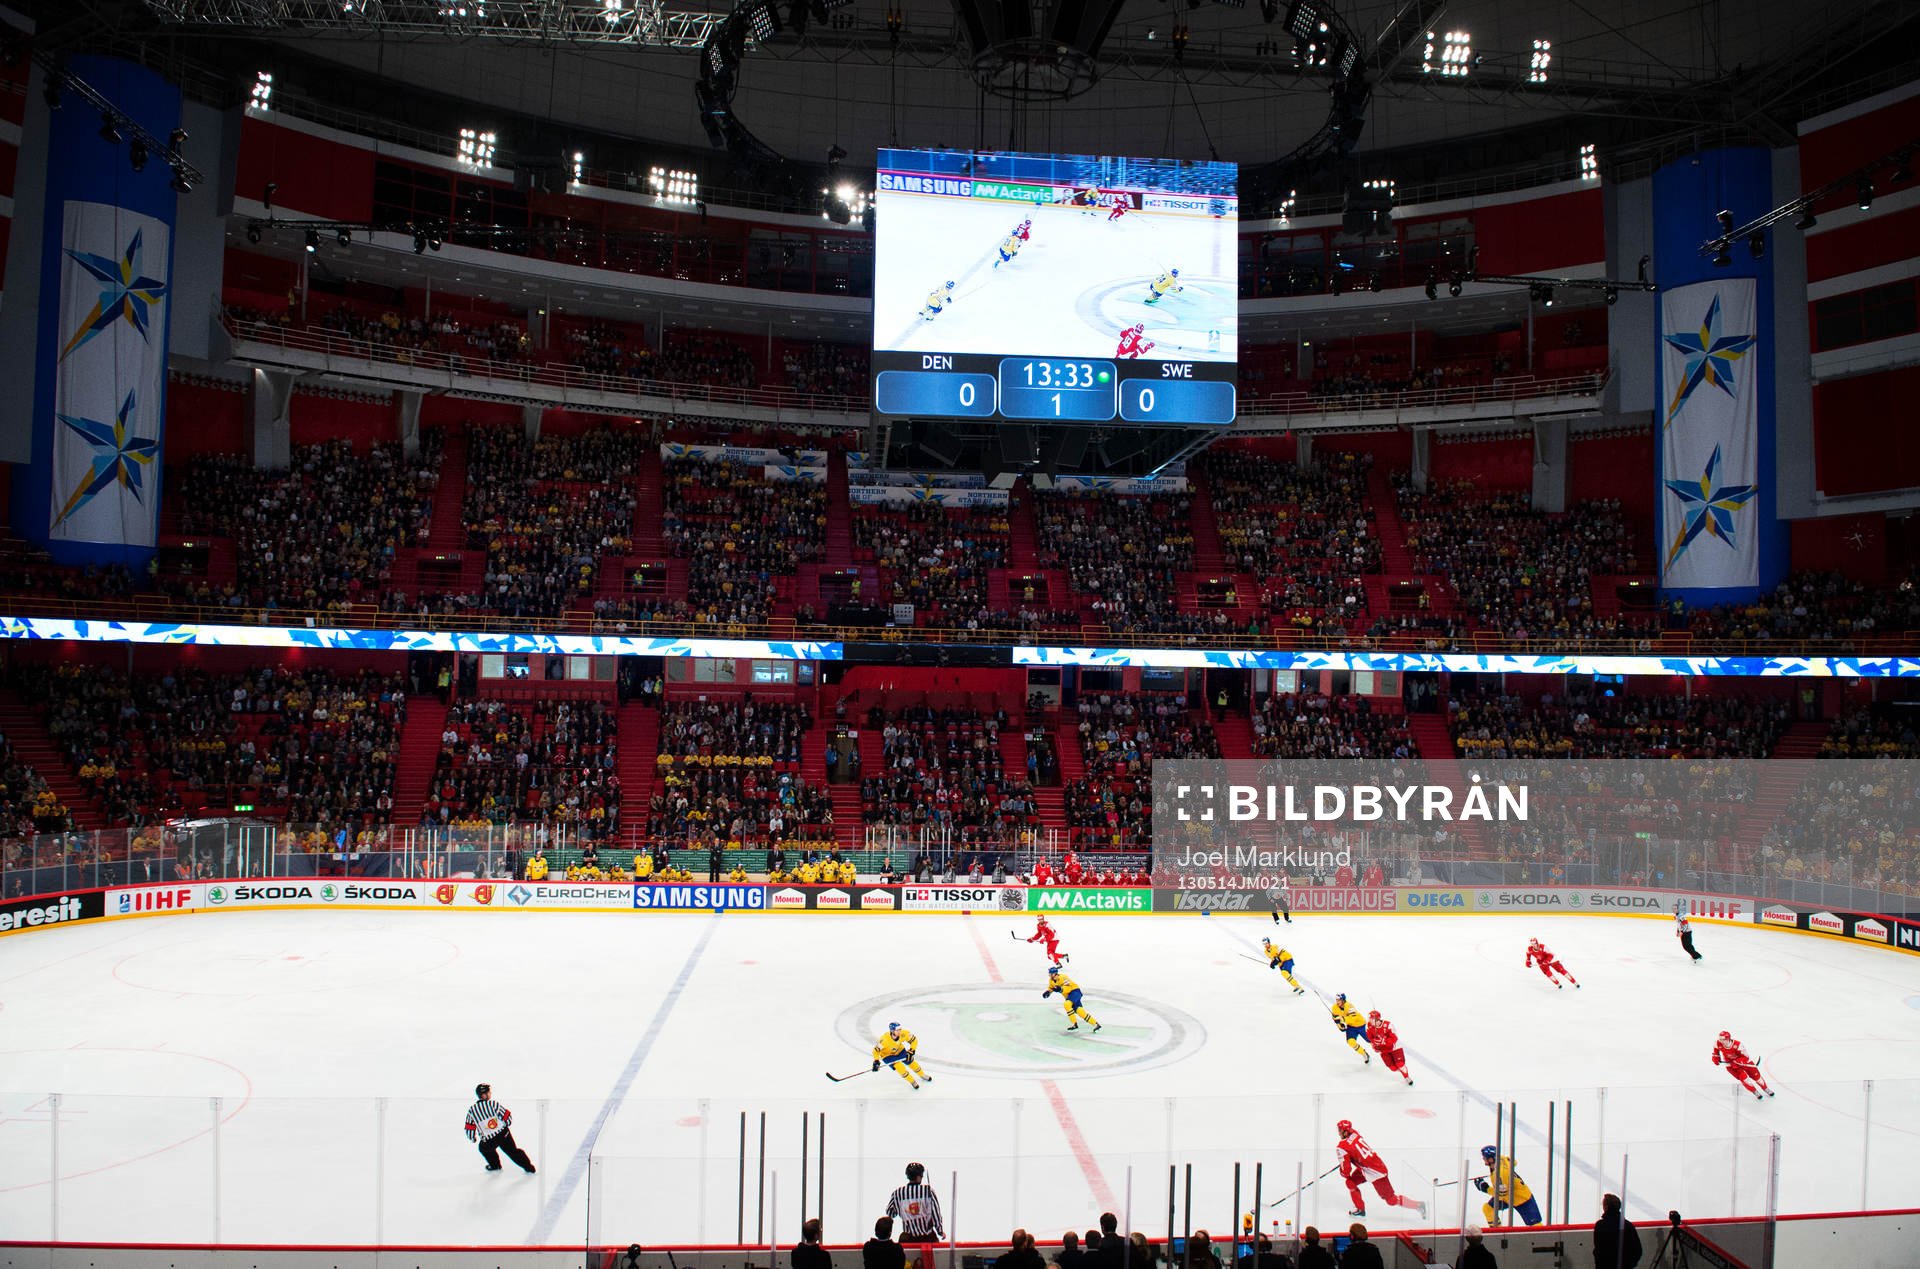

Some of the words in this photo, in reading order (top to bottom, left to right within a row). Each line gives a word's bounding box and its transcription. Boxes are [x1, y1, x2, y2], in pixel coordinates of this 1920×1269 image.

[881, 173, 971, 196] SAMSUNG
[999, 185, 1052, 202] Actavis
[1165, 198, 1207, 210] TISSOT
[923, 355, 953, 371] DEN
[1162, 364, 1193, 379] SWE
[1024, 362, 1094, 388] 13:33
[959, 383, 975, 407] 0
[1139, 389, 1155, 412] 0
[1051, 393, 1061, 416] 1
[135, 889, 192, 912] IIHF
[235, 885, 313, 900] ŠKODA
[344, 885, 417, 900] ŠKODA
[636, 887, 762, 908] SAMSUNG
[931, 890, 996, 901] TISSOT
[1072, 891, 1143, 909] Actavis
[1499, 892, 1561, 905] ŠKODA
[1590, 893, 1660, 908] ŠKODA
[1691, 899, 1742, 919] IIHF
